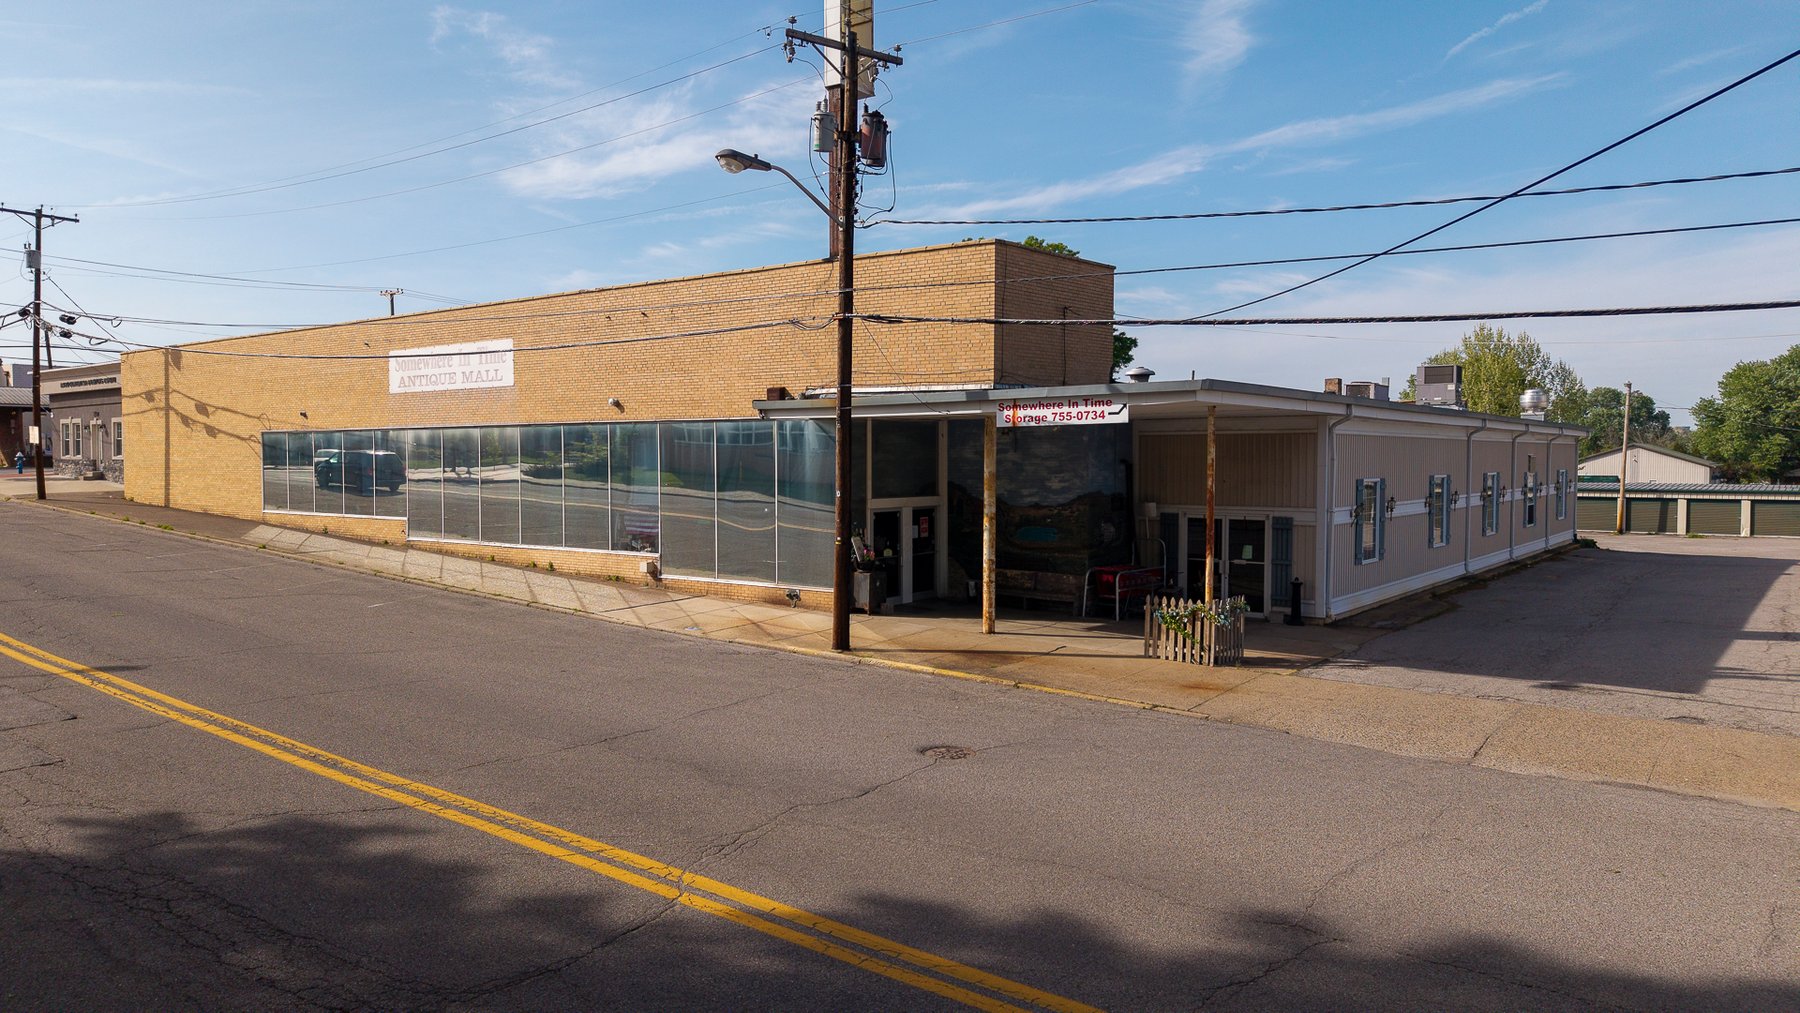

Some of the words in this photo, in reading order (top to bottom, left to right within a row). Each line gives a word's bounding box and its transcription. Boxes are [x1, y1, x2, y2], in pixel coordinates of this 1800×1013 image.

[394, 351, 453, 373] Somewhere
[477, 346, 507, 365] Time
[398, 372, 456, 388] ANTIQUE
[461, 369, 503, 384] MALL
[998, 400, 1064, 412] Somewhere
[1068, 399, 1079, 409] In
[1083, 398, 1113, 407] Time
[1051, 410, 1106, 422] 755-0734
